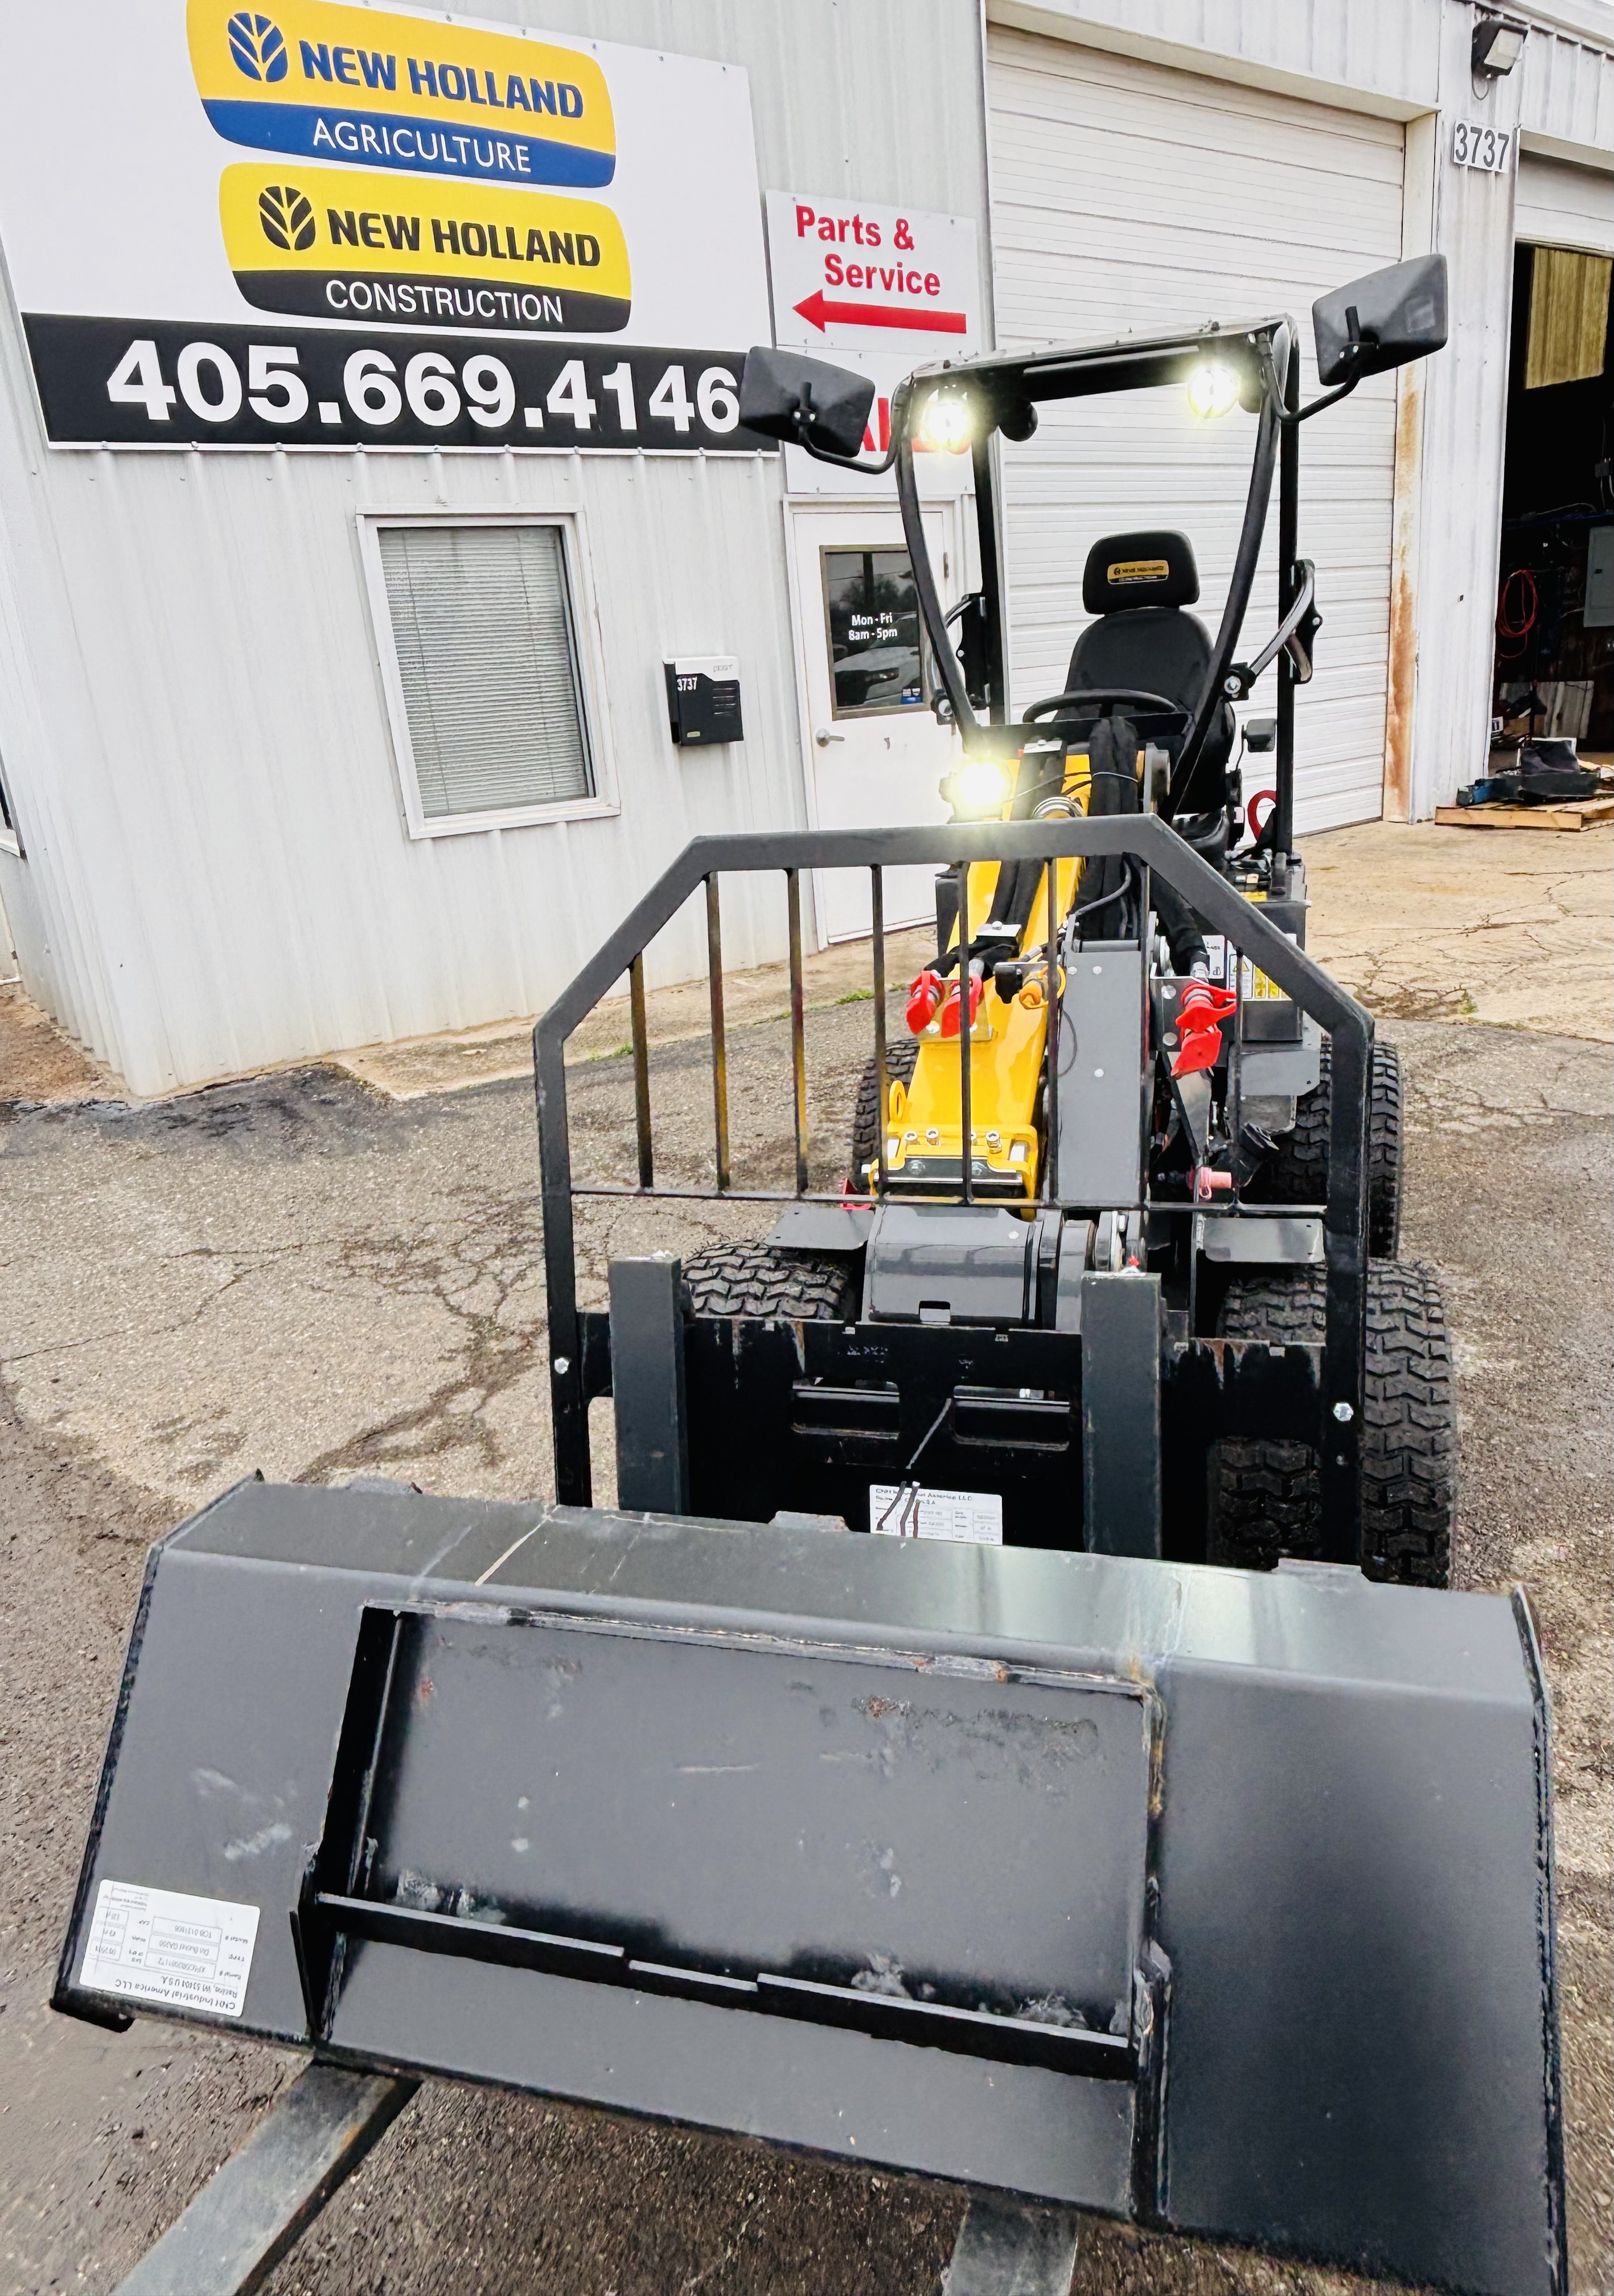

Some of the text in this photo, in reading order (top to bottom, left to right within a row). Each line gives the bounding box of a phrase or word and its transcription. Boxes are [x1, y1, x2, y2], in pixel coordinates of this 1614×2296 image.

[301, 40, 583, 118] NEW HOLLAND
[313, 117, 531, 173] AGRICULTURE
[1455, 122, 1510, 170] 3737
[327, 208, 600, 267] NEW HOLLAND
[795, 204, 915, 251] Parts &
[824, 253, 941, 296] Service
[326, 279, 563, 323] CONSTRUCTION
[106, 339, 740, 434] 405.669.4146
[848, 629, 870, 641] 8am
[877, 627, 898, 641] 5pm
[852, 614, 873, 626] Mon
[880, 612, 893, 624] Fri
[676, 676, 697, 691] 3737
